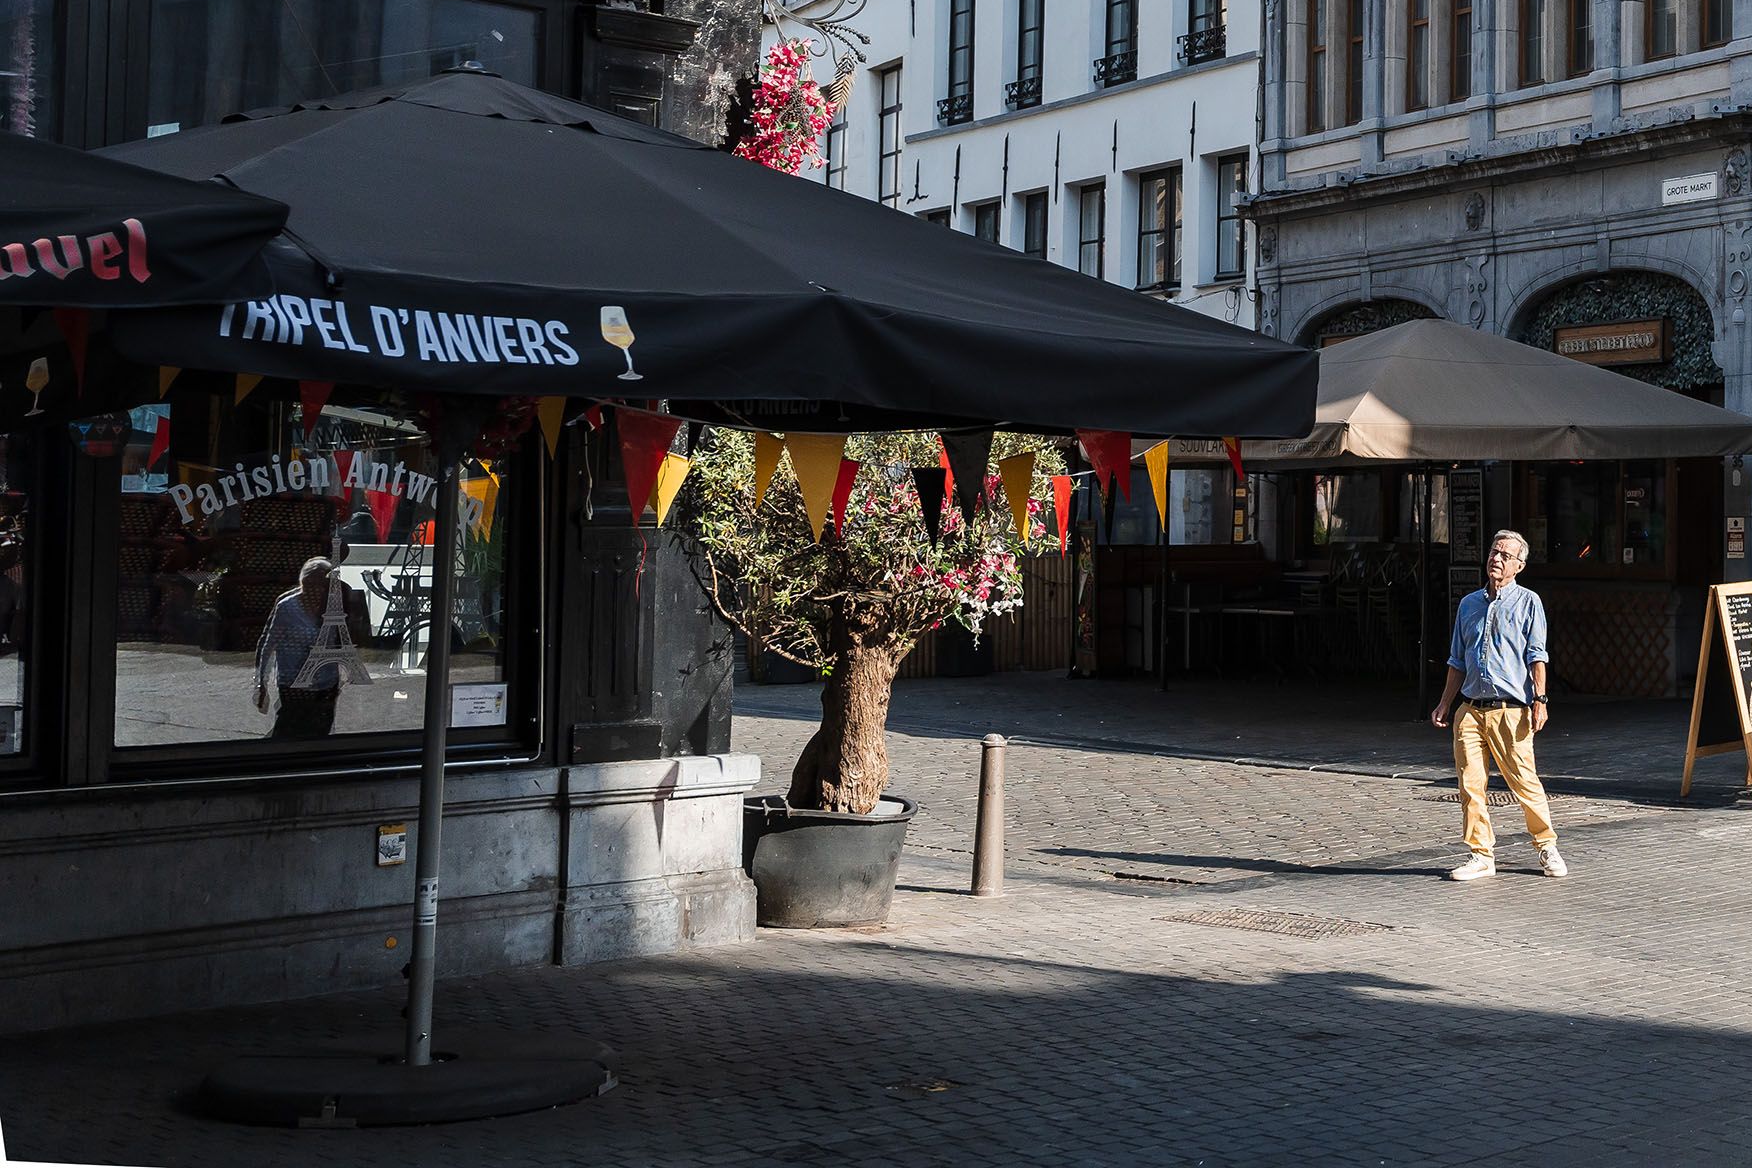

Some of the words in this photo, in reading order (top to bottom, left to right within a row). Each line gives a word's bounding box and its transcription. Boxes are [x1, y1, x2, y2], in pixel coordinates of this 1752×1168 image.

[1666, 185, 1688, 196] GROTE
[1690, 182, 1712, 192] MARKT
[369, 305, 580, 366] D'ANVERS
[1179, 439, 1229, 452] SOUVLAK
[168, 453, 330, 525] Parisien
[343, 450, 484, 531] Antwp
